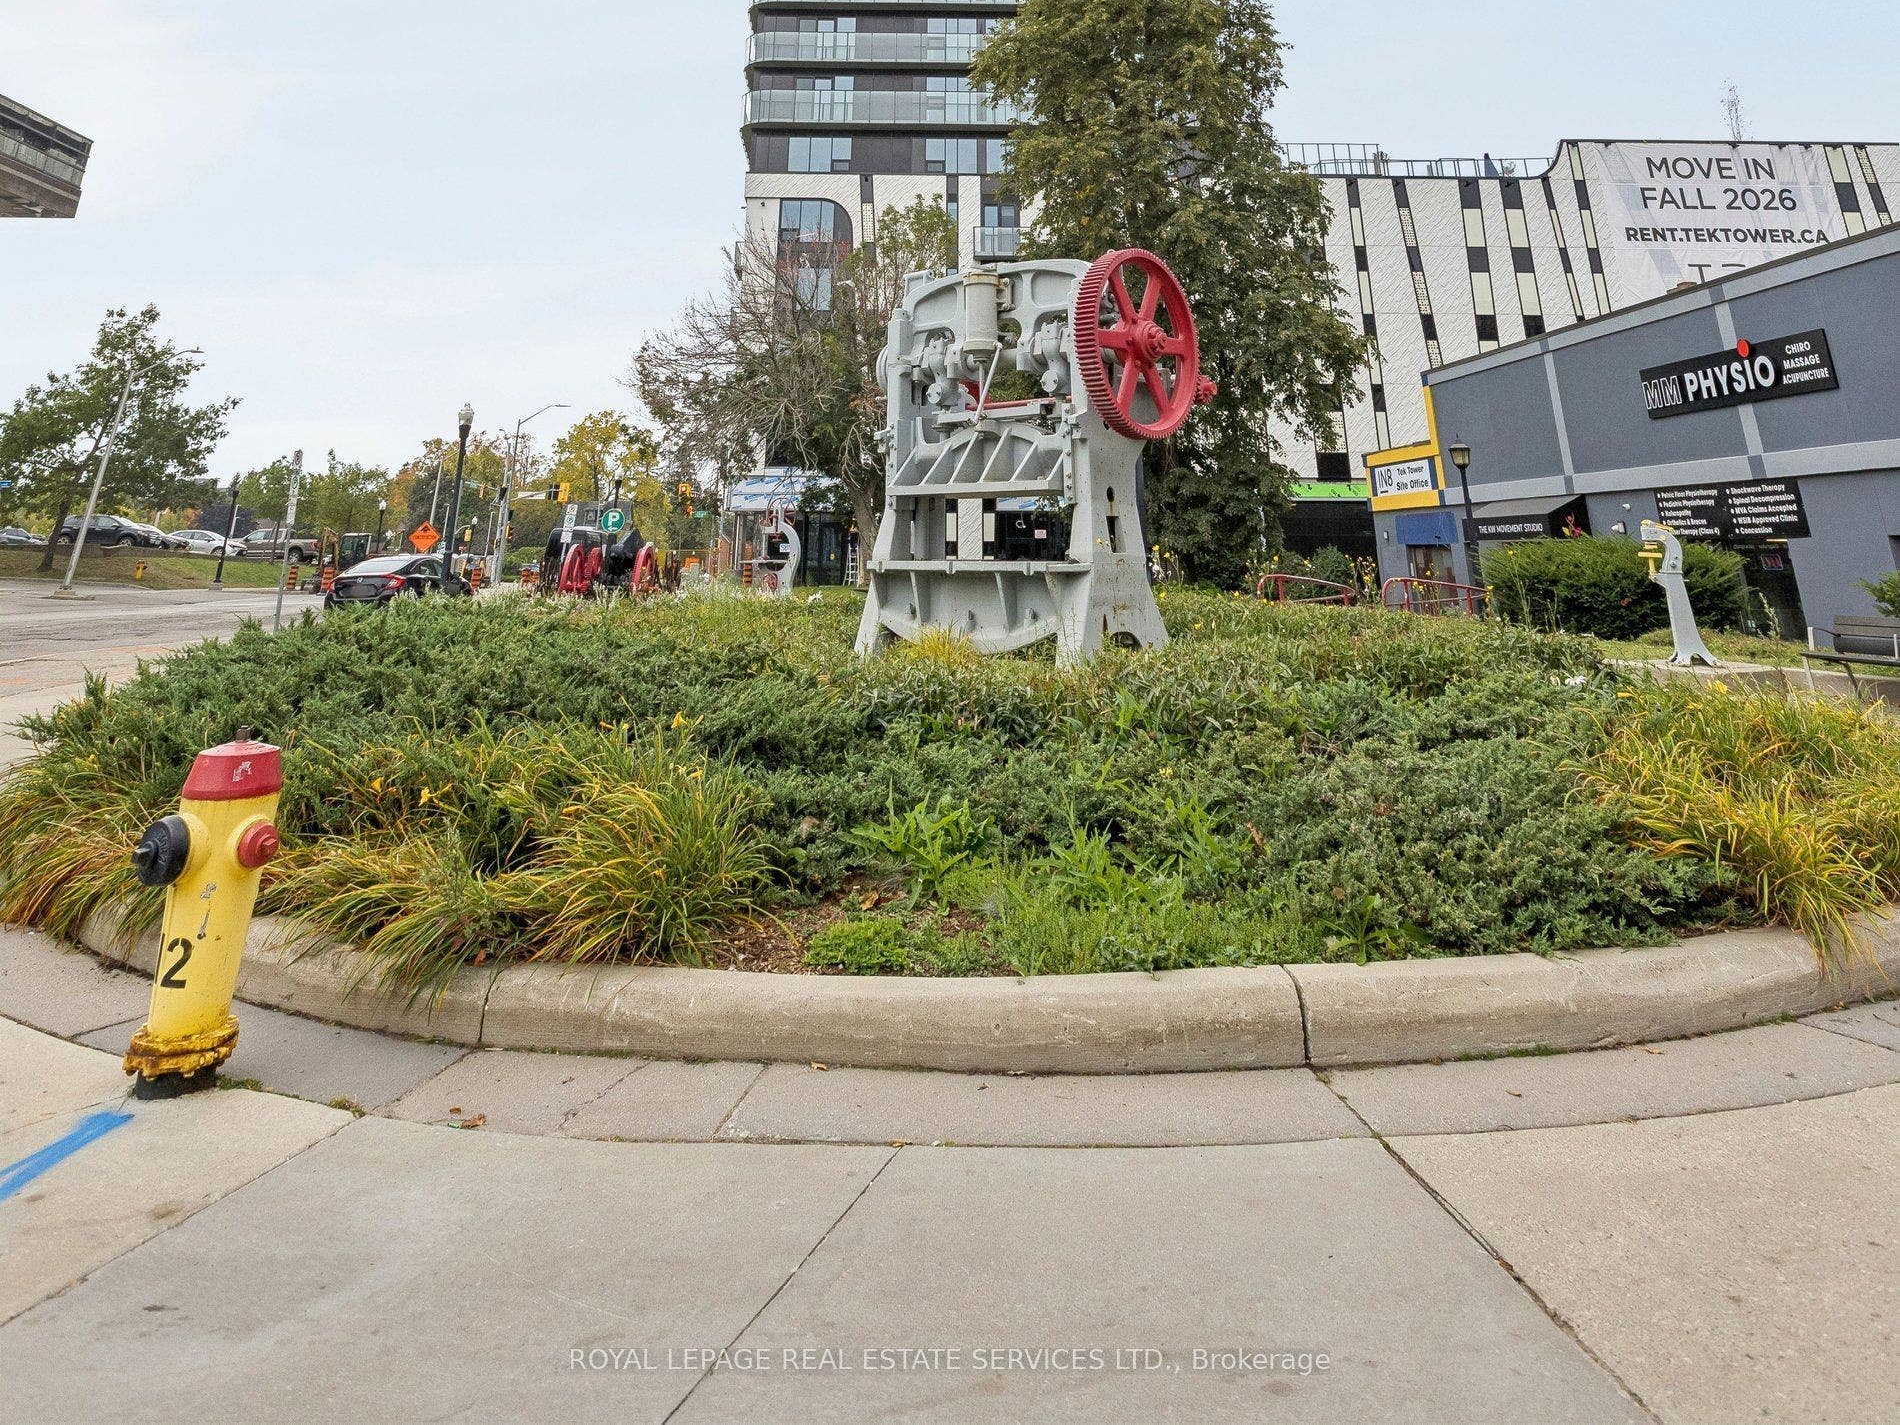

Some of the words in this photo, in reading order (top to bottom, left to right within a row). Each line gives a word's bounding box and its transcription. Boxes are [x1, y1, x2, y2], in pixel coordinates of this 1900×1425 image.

[1645, 156, 1736, 180] MOVE
[1743, 158, 1776, 180] IN
[1639, 186, 1716, 209] FALL
[1722, 187, 1797, 211] 2026
[1624, 226, 1831, 244] RENT.TEKTOWER.CA
[1784, 341, 1811, 355] CHIRO
[1782, 353, 1821, 370] MASSAGE
[1641, 375, 1683, 410] MM
[1684, 354, 1775, 402] PHYSIO
[1782, 367, 1830, 385] ACUPUNCTURE
[1396, 467, 1407, 476] Tek
[1407, 466, 1424, 475] Tower
[1377, 468, 1394, 489] IN8
[1396, 481, 1409, 491] Site
[1409, 479, 1429, 489] Office
[1730, 486, 1761, 495] Shockwave
[1761, 484, 1785, 492] Therapy
[1732, 496, 1750, 505] Spinal
[1750, 493, 1796, 503] Decompression
[1747, 505, 1768, 513] Claims
[1768, 504, 1798, 513] Accepted
[1752, 515, 1780, 524] Approved
[1780, 514, 1799, 522] Clinic
[1478, 525, 1488, 534] THE
[1487, 525, 1496, 533] KW
[1496, 524, 1523, 533] MOVEMENT
[1524, 523, 1544, 532] STUDIO
[1740, 526, 1773, 535] Concussion
